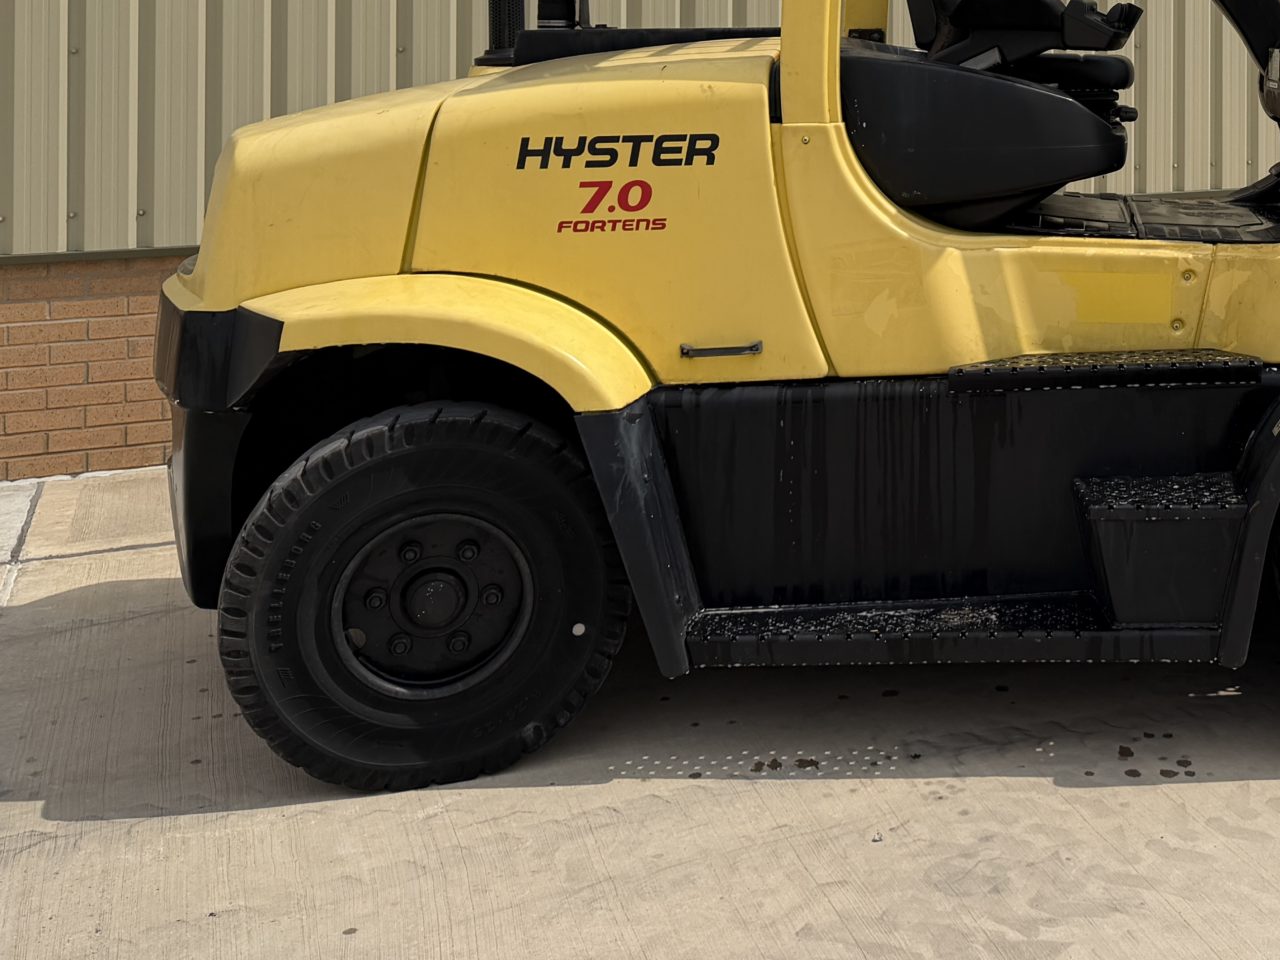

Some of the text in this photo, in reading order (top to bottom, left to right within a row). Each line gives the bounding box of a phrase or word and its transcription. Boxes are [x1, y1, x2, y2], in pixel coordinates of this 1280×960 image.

[515, 133, 720, 170] HYSTER
[578, 179, 653, 214] 7.0
[556, 217, 667, 234] FORTENS
